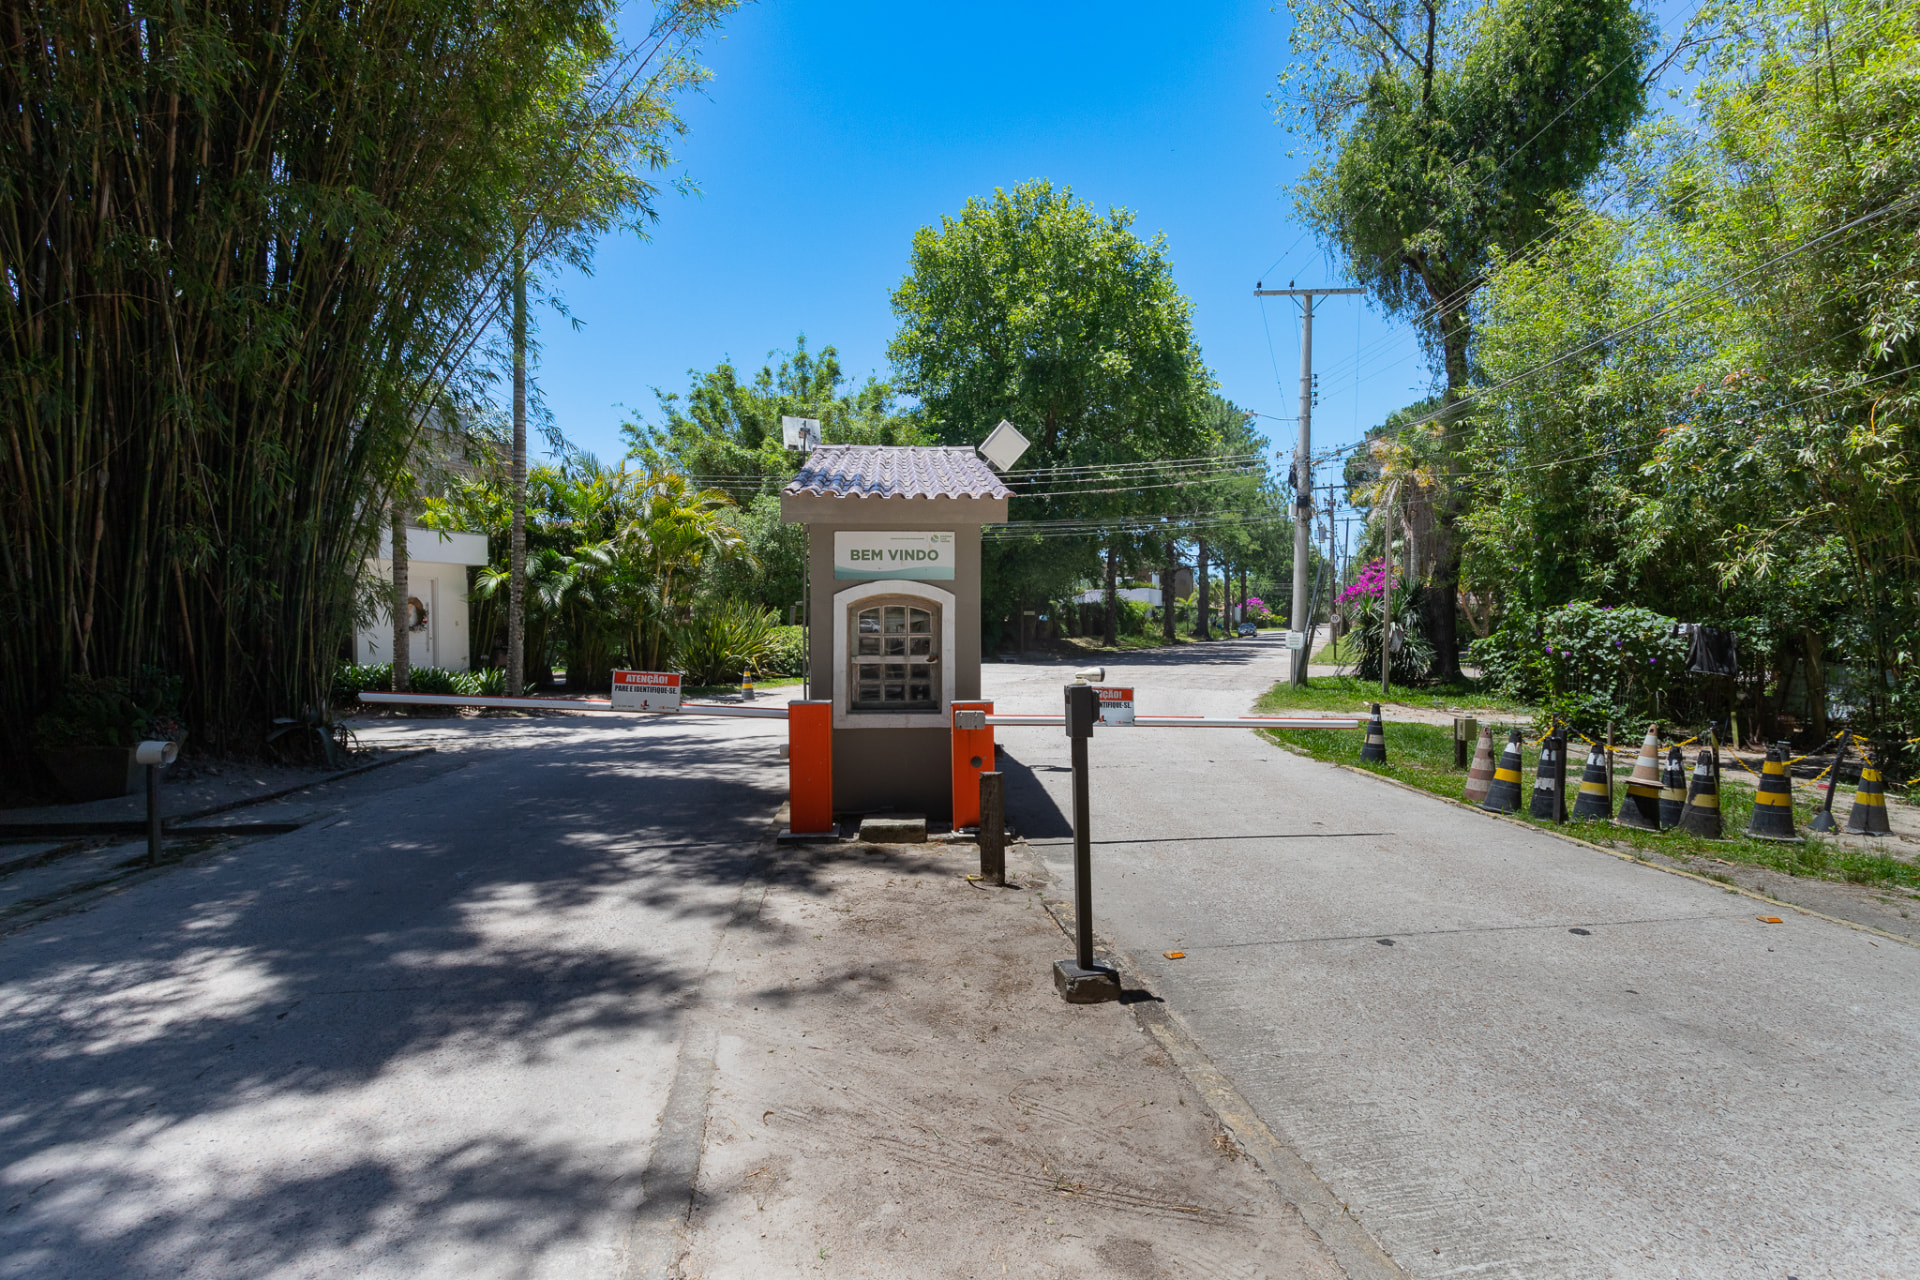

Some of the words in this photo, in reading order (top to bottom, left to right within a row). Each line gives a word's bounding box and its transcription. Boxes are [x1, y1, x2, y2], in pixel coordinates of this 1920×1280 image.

[850, 549, 883, 561] BEM
[888, 549, 939, 561] VINDO
[625, 674, 668, 685] ATENÇÃO!
